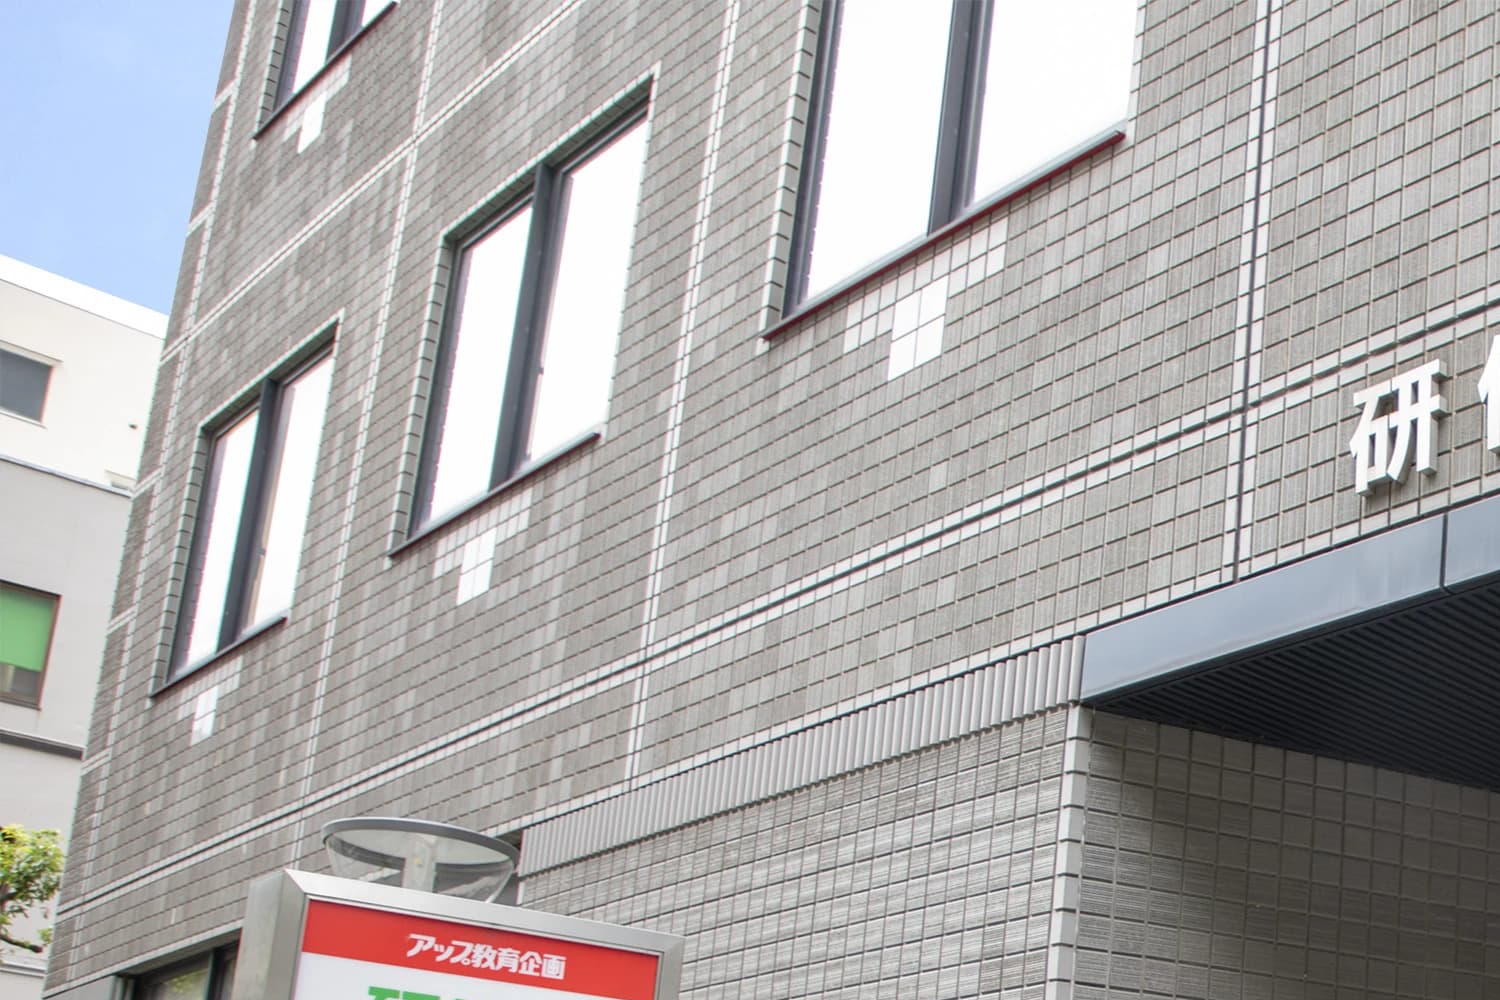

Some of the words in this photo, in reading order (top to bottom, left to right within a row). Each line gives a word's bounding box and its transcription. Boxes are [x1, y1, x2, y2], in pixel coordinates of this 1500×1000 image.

[406, 932, 567, 980] アップ教育企画
